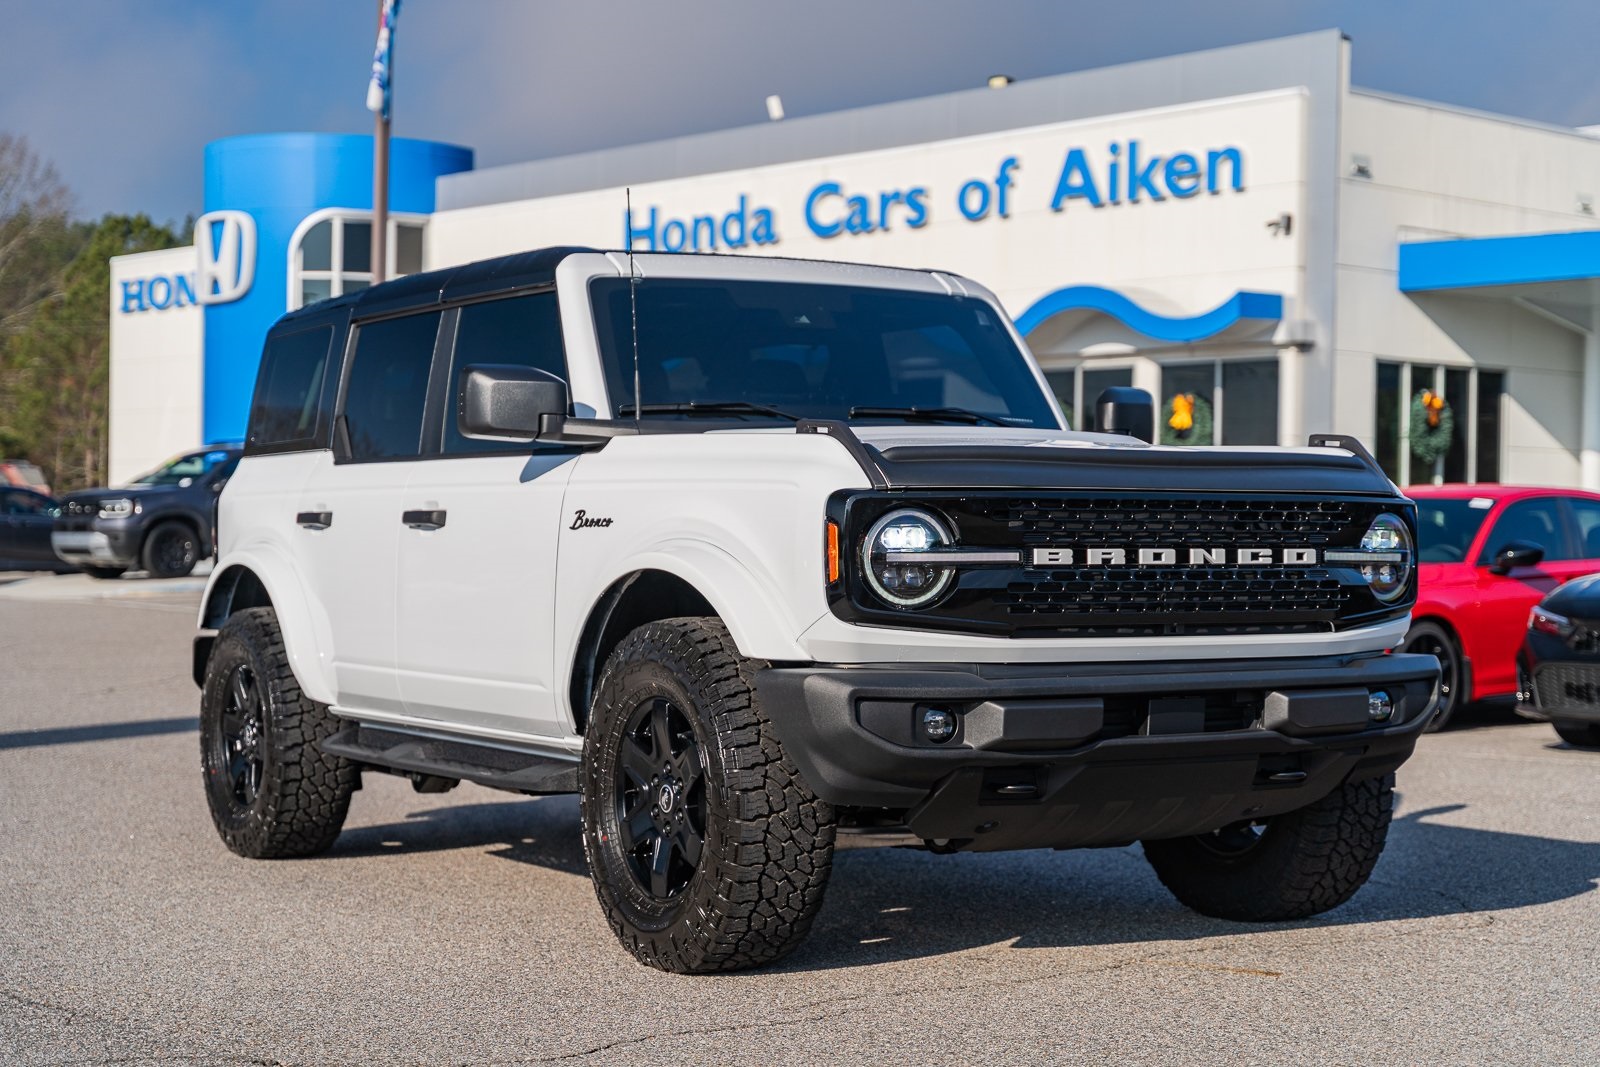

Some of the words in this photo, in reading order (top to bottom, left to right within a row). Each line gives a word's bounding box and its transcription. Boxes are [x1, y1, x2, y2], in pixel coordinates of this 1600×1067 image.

[623, 191, 777, 253] Honda
[803, 180, 928, 240] Cars
[957, 155, 1019, 221] of
[1049, 138, 1245, 213] Aiken
[569, 509, 613, 530] Bronco
[1033, 548, 1317, 565] BRONCO
